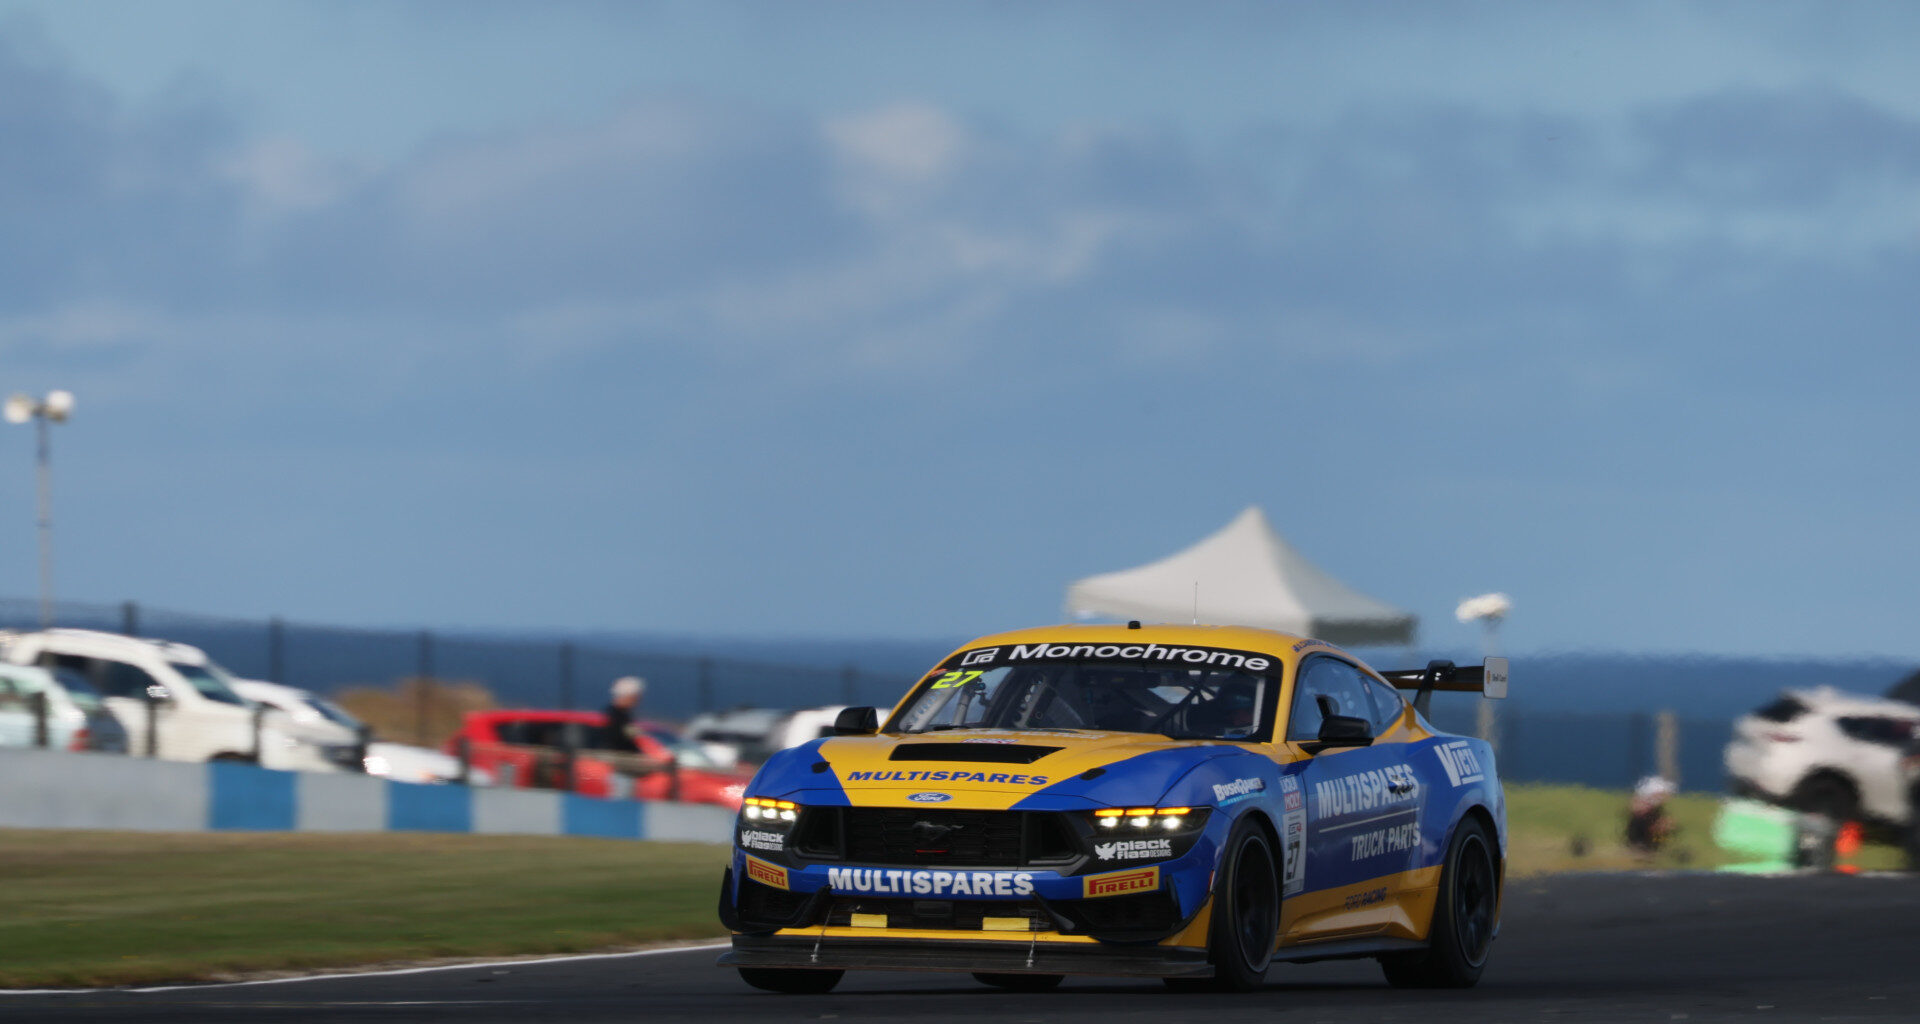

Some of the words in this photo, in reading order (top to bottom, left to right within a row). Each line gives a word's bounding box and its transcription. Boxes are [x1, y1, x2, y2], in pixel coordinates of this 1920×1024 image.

[1008, 643, 1270, 671] Monochrome
[930, 671, 984, 689] 27
[847, 771, 1048, 785] MULTISPARES
[912, 792, 946, 802] Ford
[1316, 764, 1419, 819] MULTISPARES
[751, 830, 785, 843] black
[1117, 839, 1171, 850] black
[1352, 829, 1385, 861] TRUCK
[1388, 822, 1421, 852] PARTS
[1117, 849, 1149, 859] flag
[1149, 849, 1172, 858] DESIGNS
[748, 860, 785, 887] PIRELLI
[828, 868, 1034, 895] MULTISPARES
[1089, 871, 1154, 895] PIRELLI
